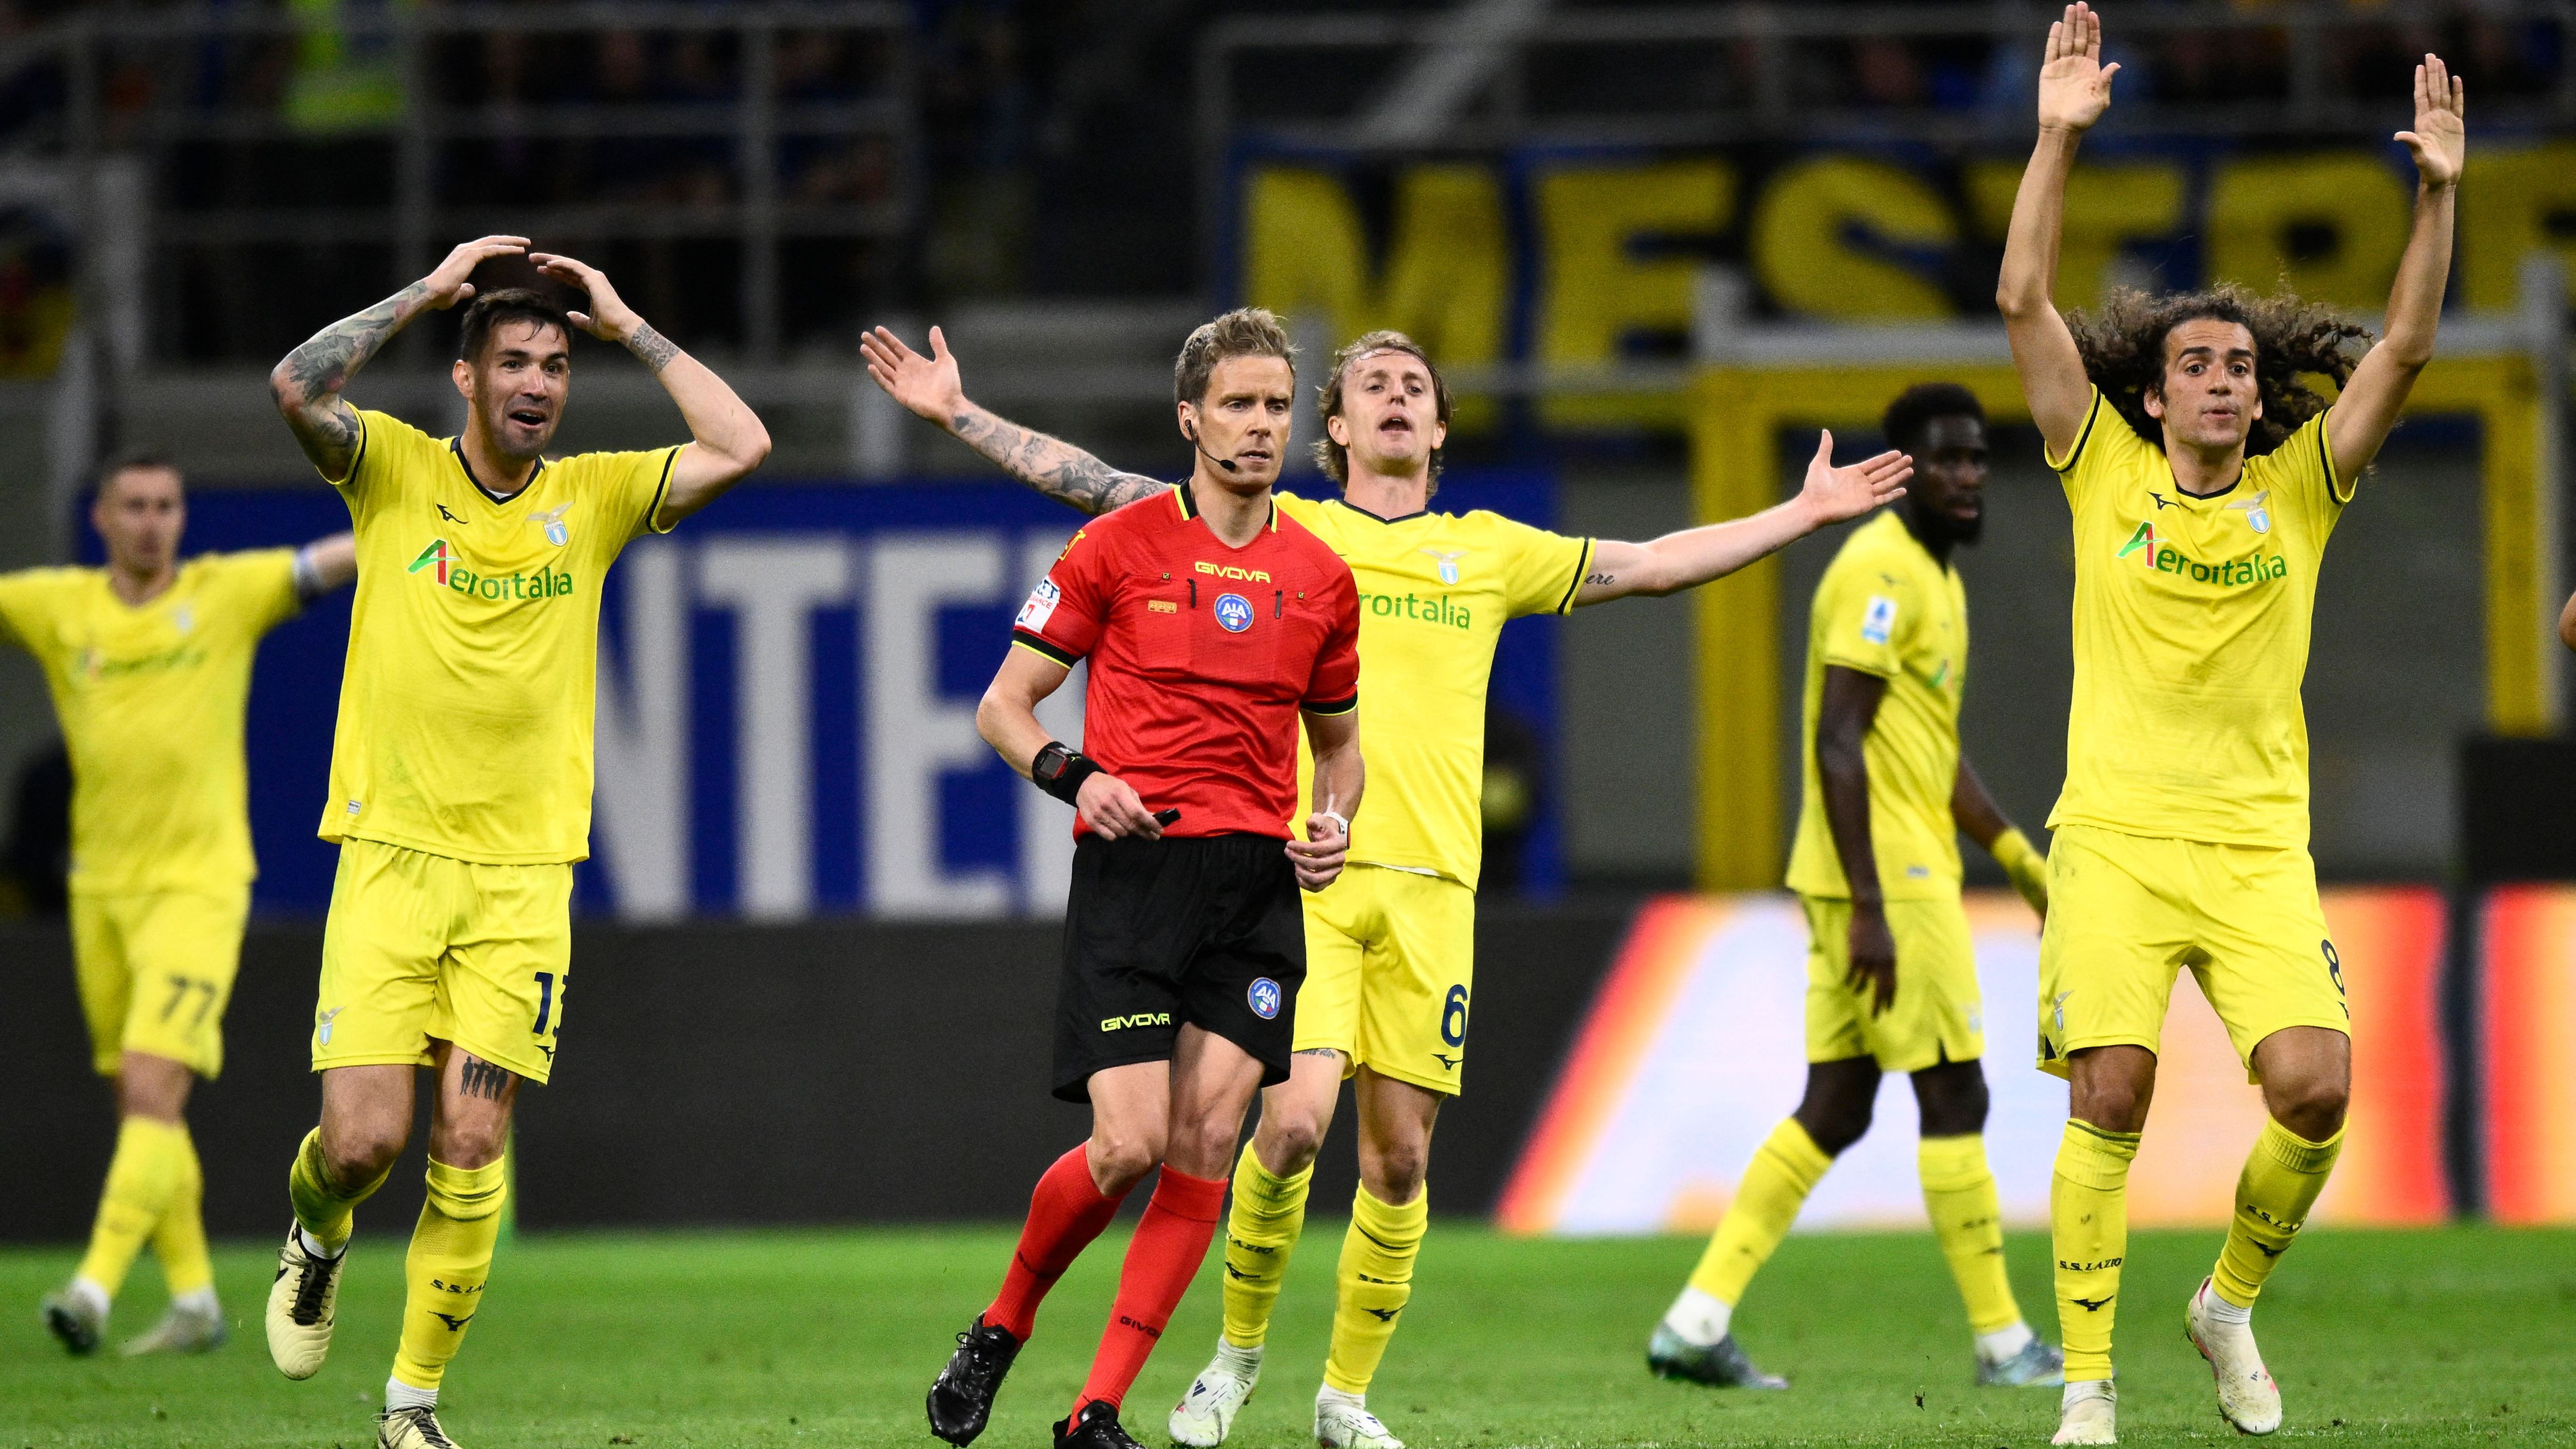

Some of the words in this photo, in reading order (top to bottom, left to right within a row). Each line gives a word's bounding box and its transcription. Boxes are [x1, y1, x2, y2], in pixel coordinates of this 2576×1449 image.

[408, 539, 573, 600] Aeroitalia
[1194, 561, 1272, 584] GIVOVA
[2116, 520, 2287, 586] Aeroitalia
[1221, 602, 1247, 619] AIA
[1359, 592, 1471, 630] roitalia
[591, 535, 1086, 924] NTE
[2321, 939, 2345, 997] 8
[1101, 1012, 1171, 1032] GIVOVA
[1255, 986, 1276, 1010] AIA
[1440, 984, 1468, 1048] 6
